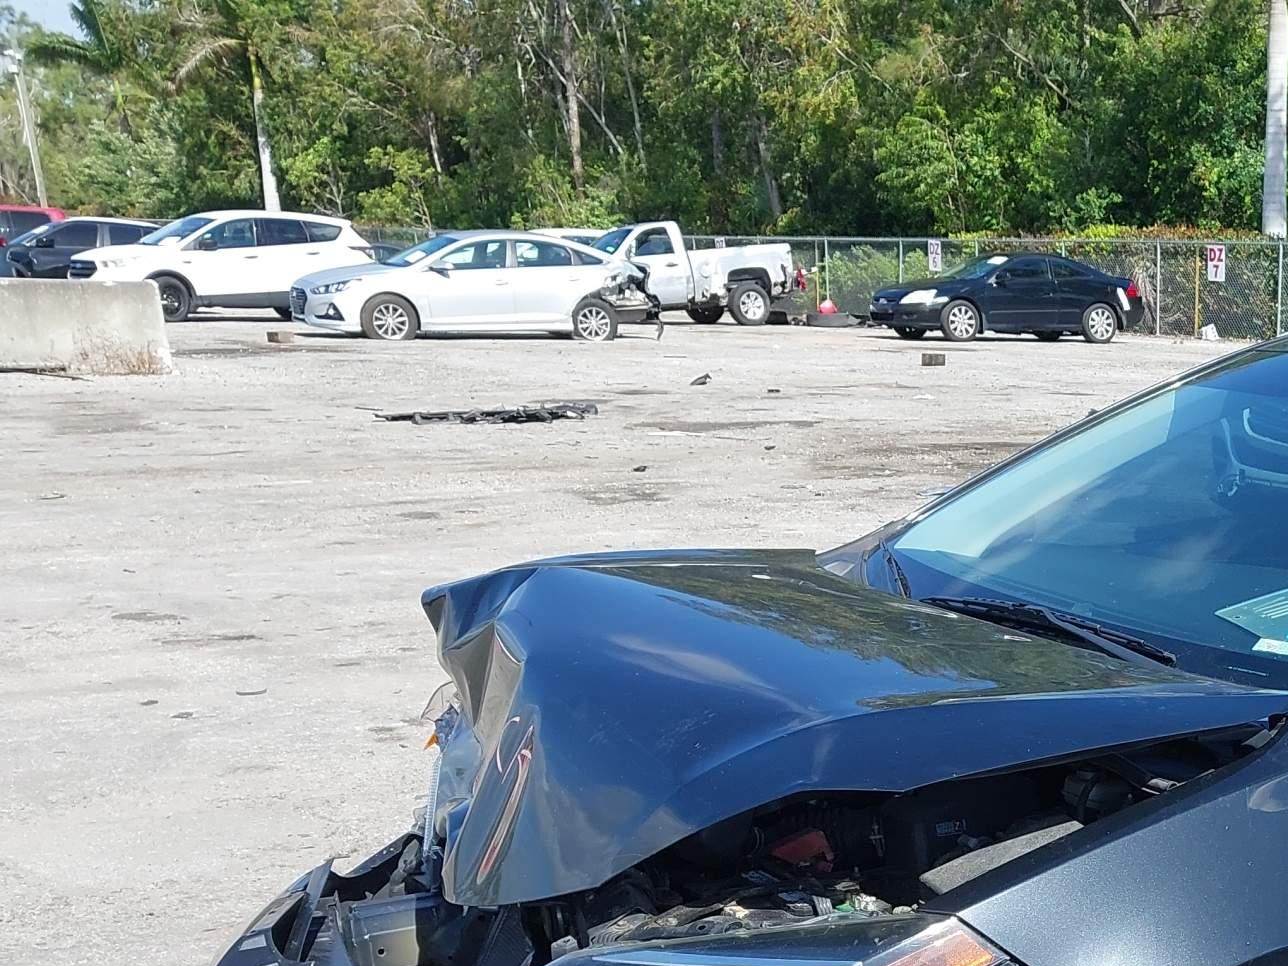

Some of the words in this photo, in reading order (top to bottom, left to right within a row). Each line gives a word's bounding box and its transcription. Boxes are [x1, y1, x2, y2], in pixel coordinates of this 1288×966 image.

[929, 242, 940, 255] DZ
[1208, 247, 1224, 263] DZ
[1212, 264, 1220, 279] 7
